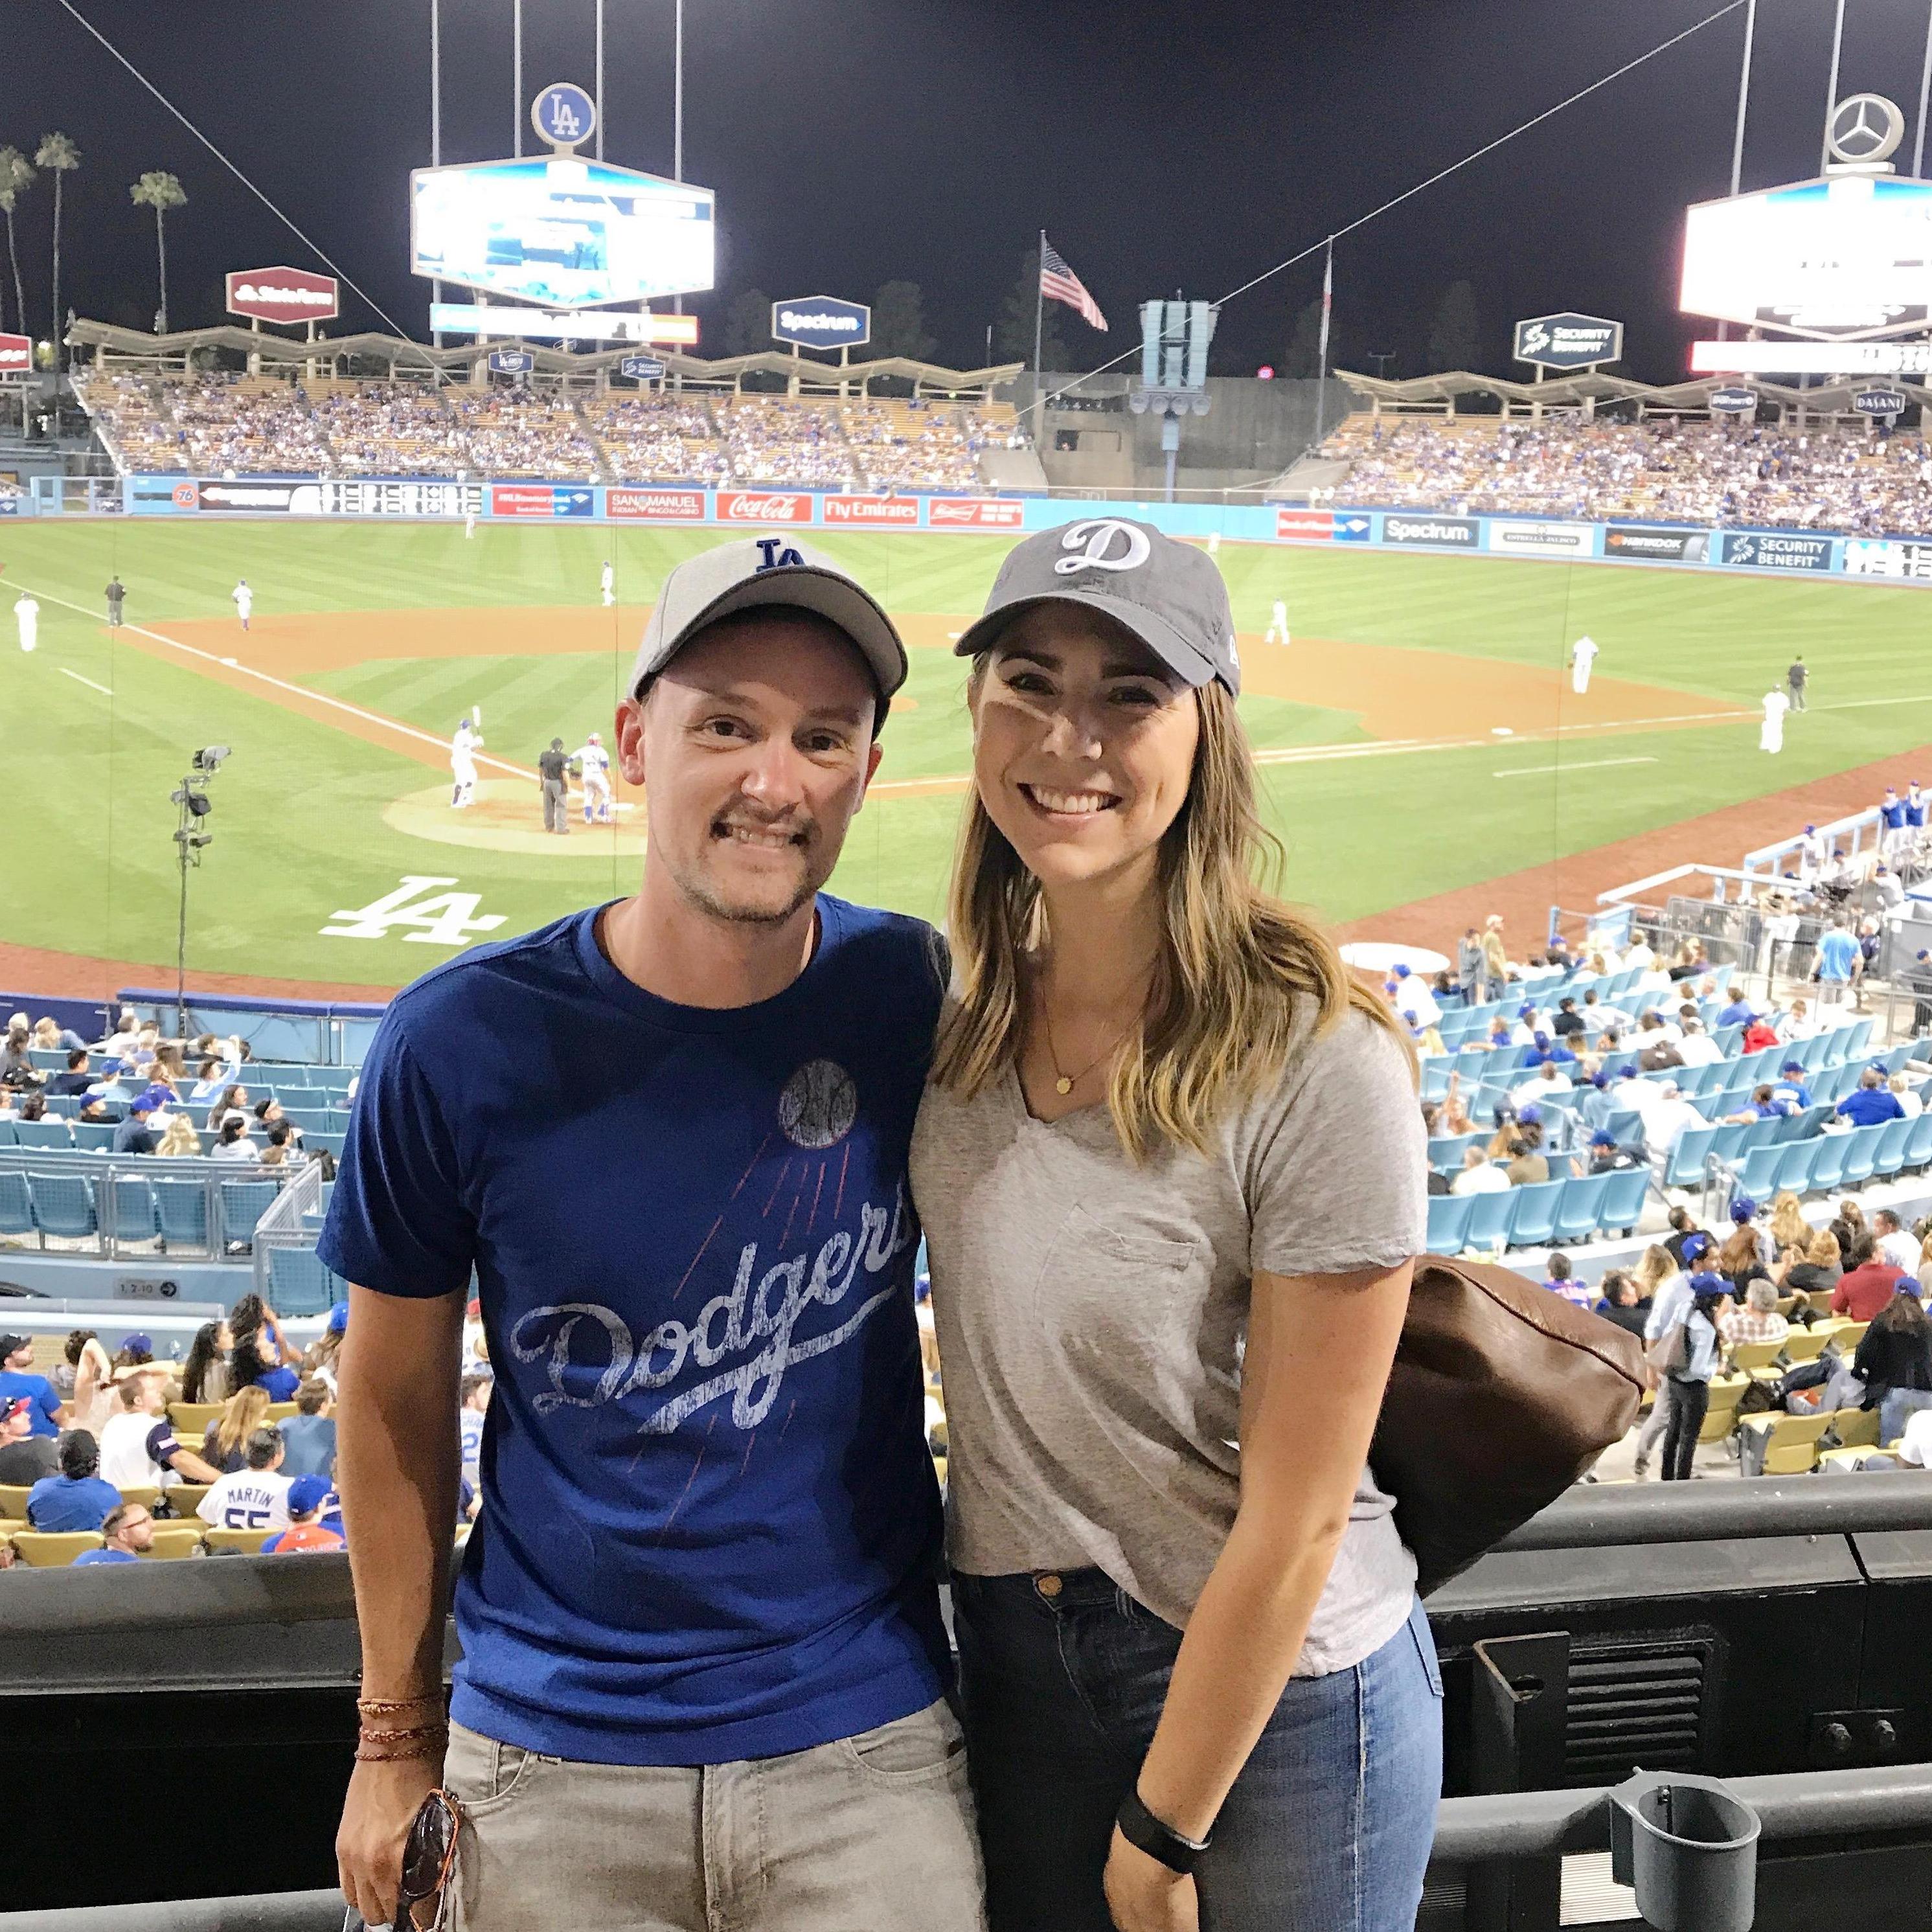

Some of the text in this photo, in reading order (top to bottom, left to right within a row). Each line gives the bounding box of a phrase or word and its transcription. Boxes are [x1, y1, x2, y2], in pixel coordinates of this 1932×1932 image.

[551, 94, 580, 135] LA
[780, 311, 858, 332] Spectrum
[1858, 396, 1900, 409] DASANI
[178, 490, 194, 501] 76
[612, 494, 699, 508] SAN MANUEL
[729, 495, 798, 519] Coca-Cola
[827, 501, 850, 518] Fly
[853, 502, 916, 517] Emirates
[1388, 520, 1469, 541] Spectrum
[1054, 519, 1150, 575] D
[1759, 537, 1826, 554] SECURITY
[317, 876, 508, 946] LA
[227, 1488, 275, 1508] MARTIN
[225, 1508, 270, 1529] 55
